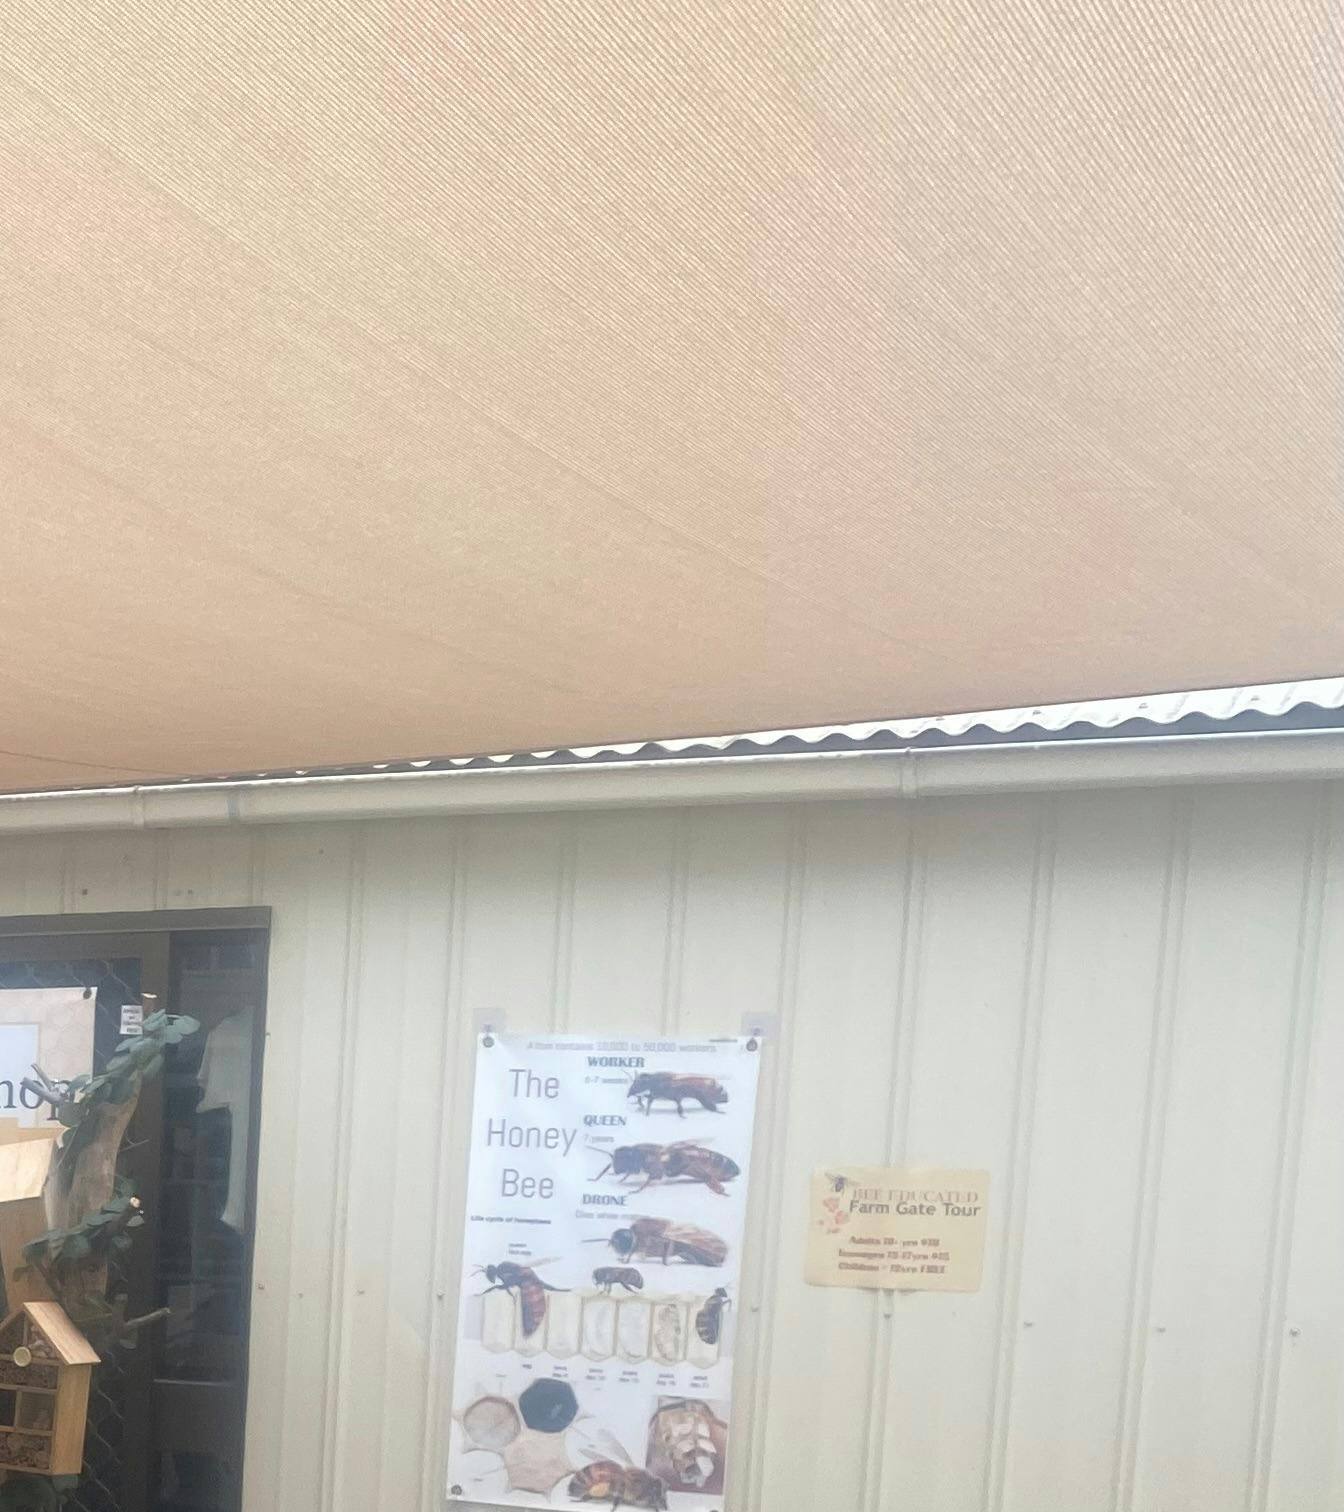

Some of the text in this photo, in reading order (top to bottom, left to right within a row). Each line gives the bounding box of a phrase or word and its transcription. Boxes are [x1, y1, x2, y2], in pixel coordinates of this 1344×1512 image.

[587, 1056, 645, 1068] WORKER
[508, 1067, 560, 1099] The
[583, 1114, 627, 1127] QUEEN
[486, 1117, 578, 1157] Honey
[500, 1168, 555, 1199] Bee
[582, 1193, 629, 1206] DRONE
[853, 1188, 979, 1203] BEE EDUCATED
[849, 1200, 981, 1217] Farm Gate Tour
